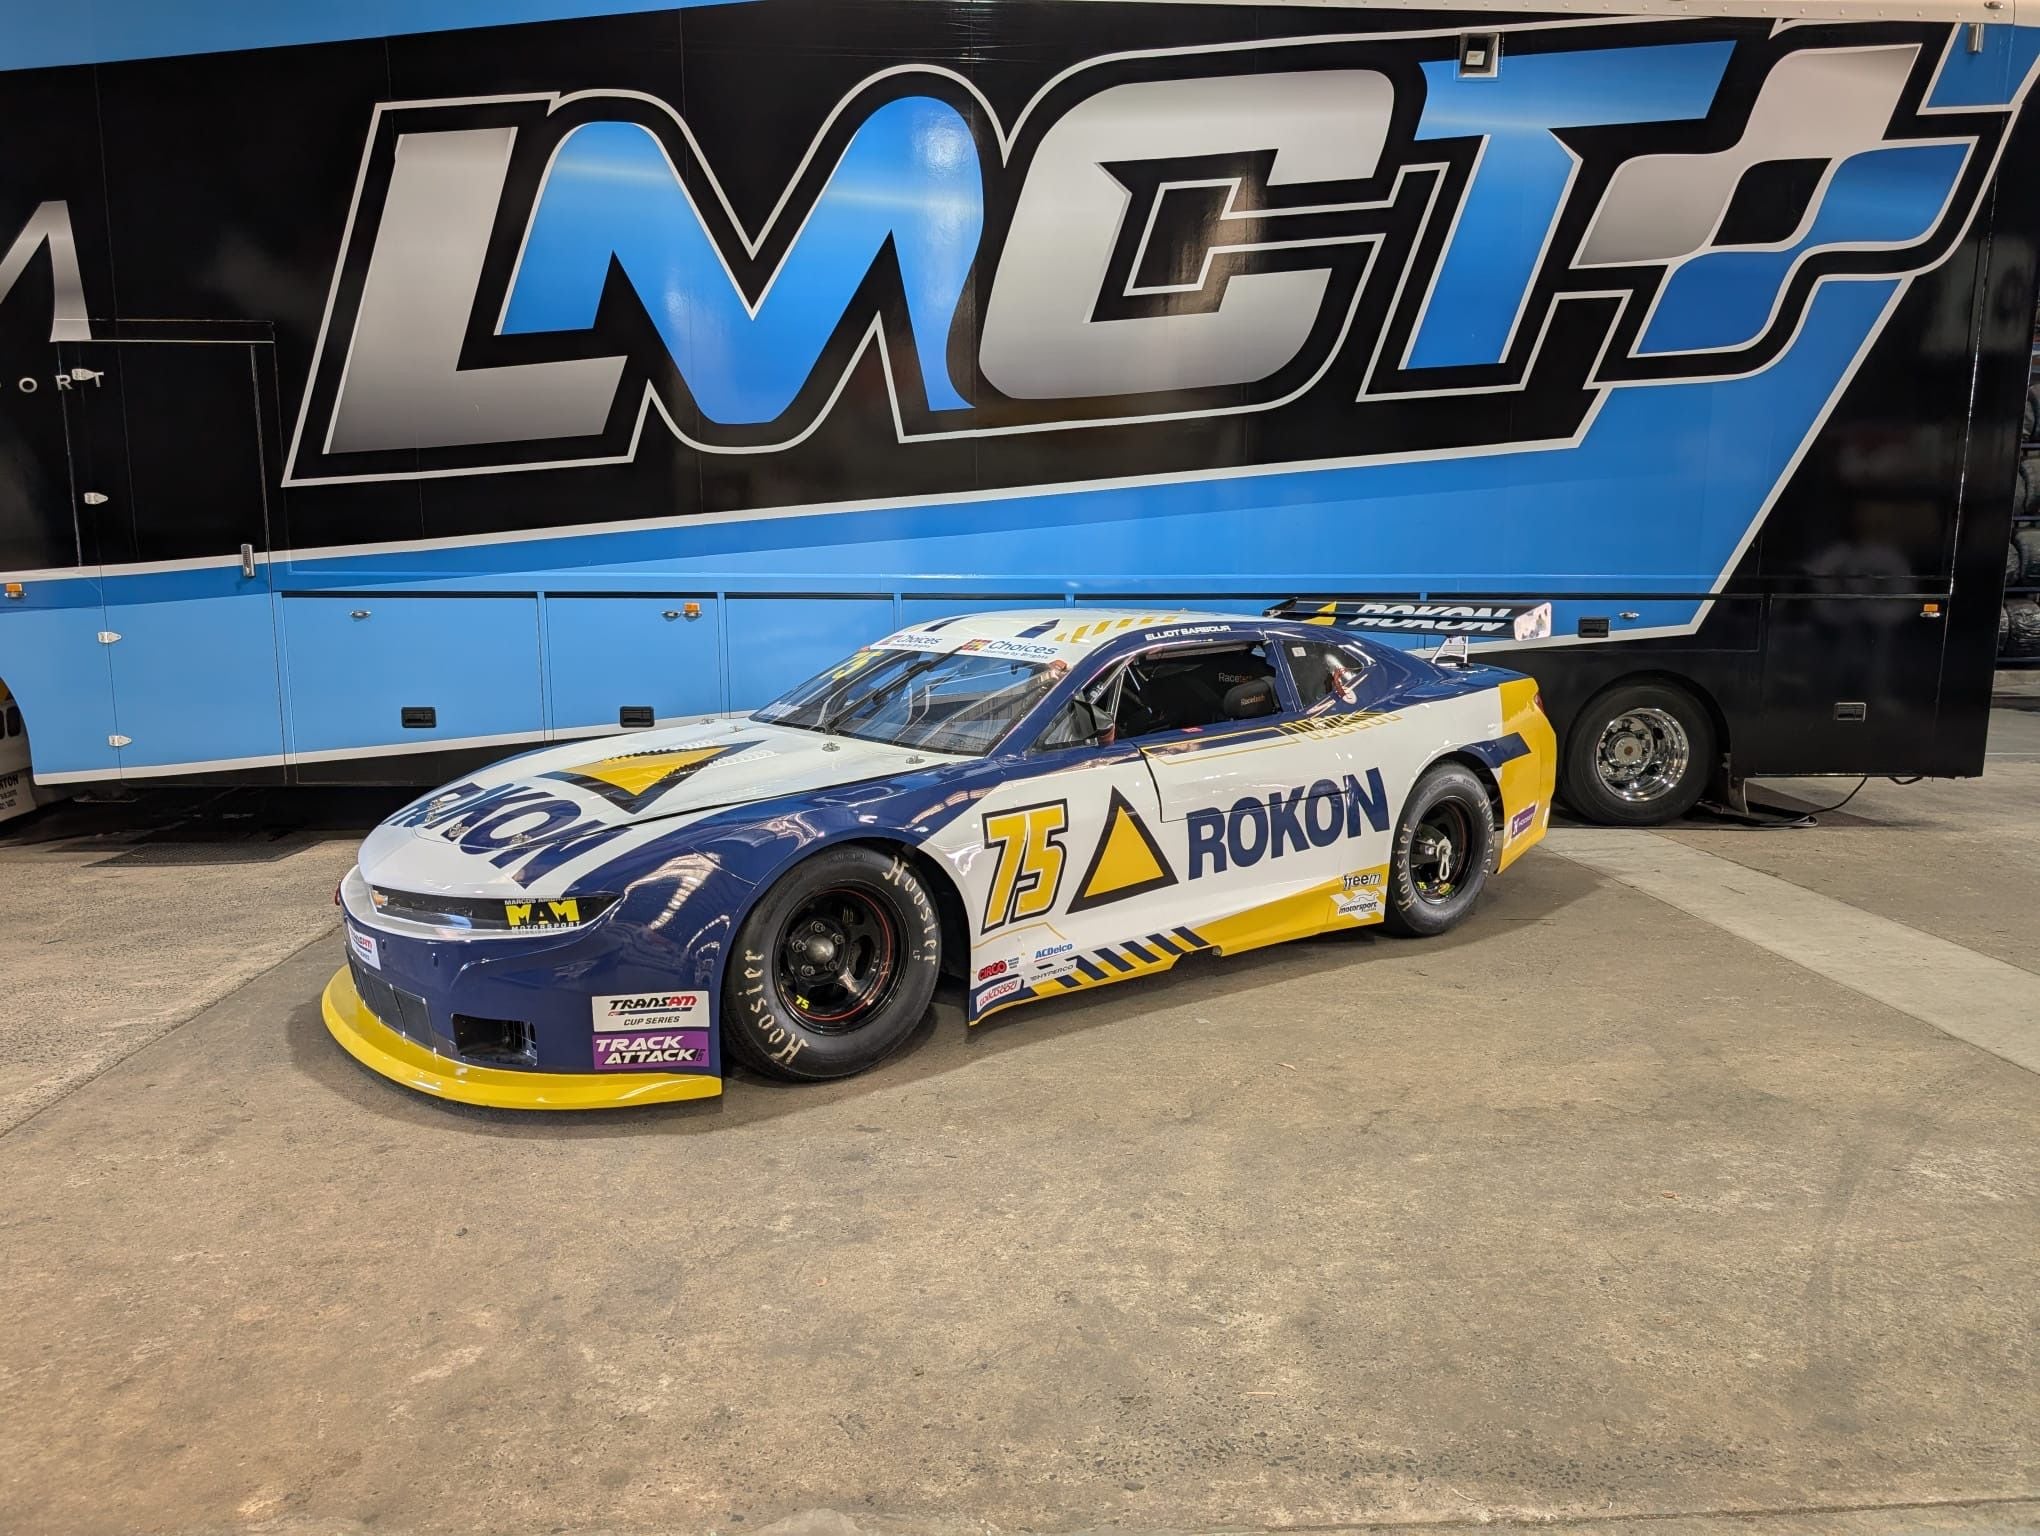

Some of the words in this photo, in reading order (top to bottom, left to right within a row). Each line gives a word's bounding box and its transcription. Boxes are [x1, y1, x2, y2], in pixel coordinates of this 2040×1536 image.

[1145, 629, 1180, 641] ELLIOT
[1180, 625, 1231, 636] BARBOUR
[987, 640, 1059, 656] Choices
[1187, 767, 1390, 881] ROKON
[981, 798, 1070, 935] 75
[1343, 873, 1381, 890] freem
[882, 855, 939, 967] Hoosier
[511, 921, 580, 932] MOTORSPORT
[1035, 943, 1073, 959] ACDelco
[738, 950, 809, 1065] Hoosier
[623, 1017, 645, 1027] CUP
[645, 1015, 681, 1026] SERIES
[595, 1035, 684, 1053] TRACK
[603, 1049, 696, 1066] ATTACK
